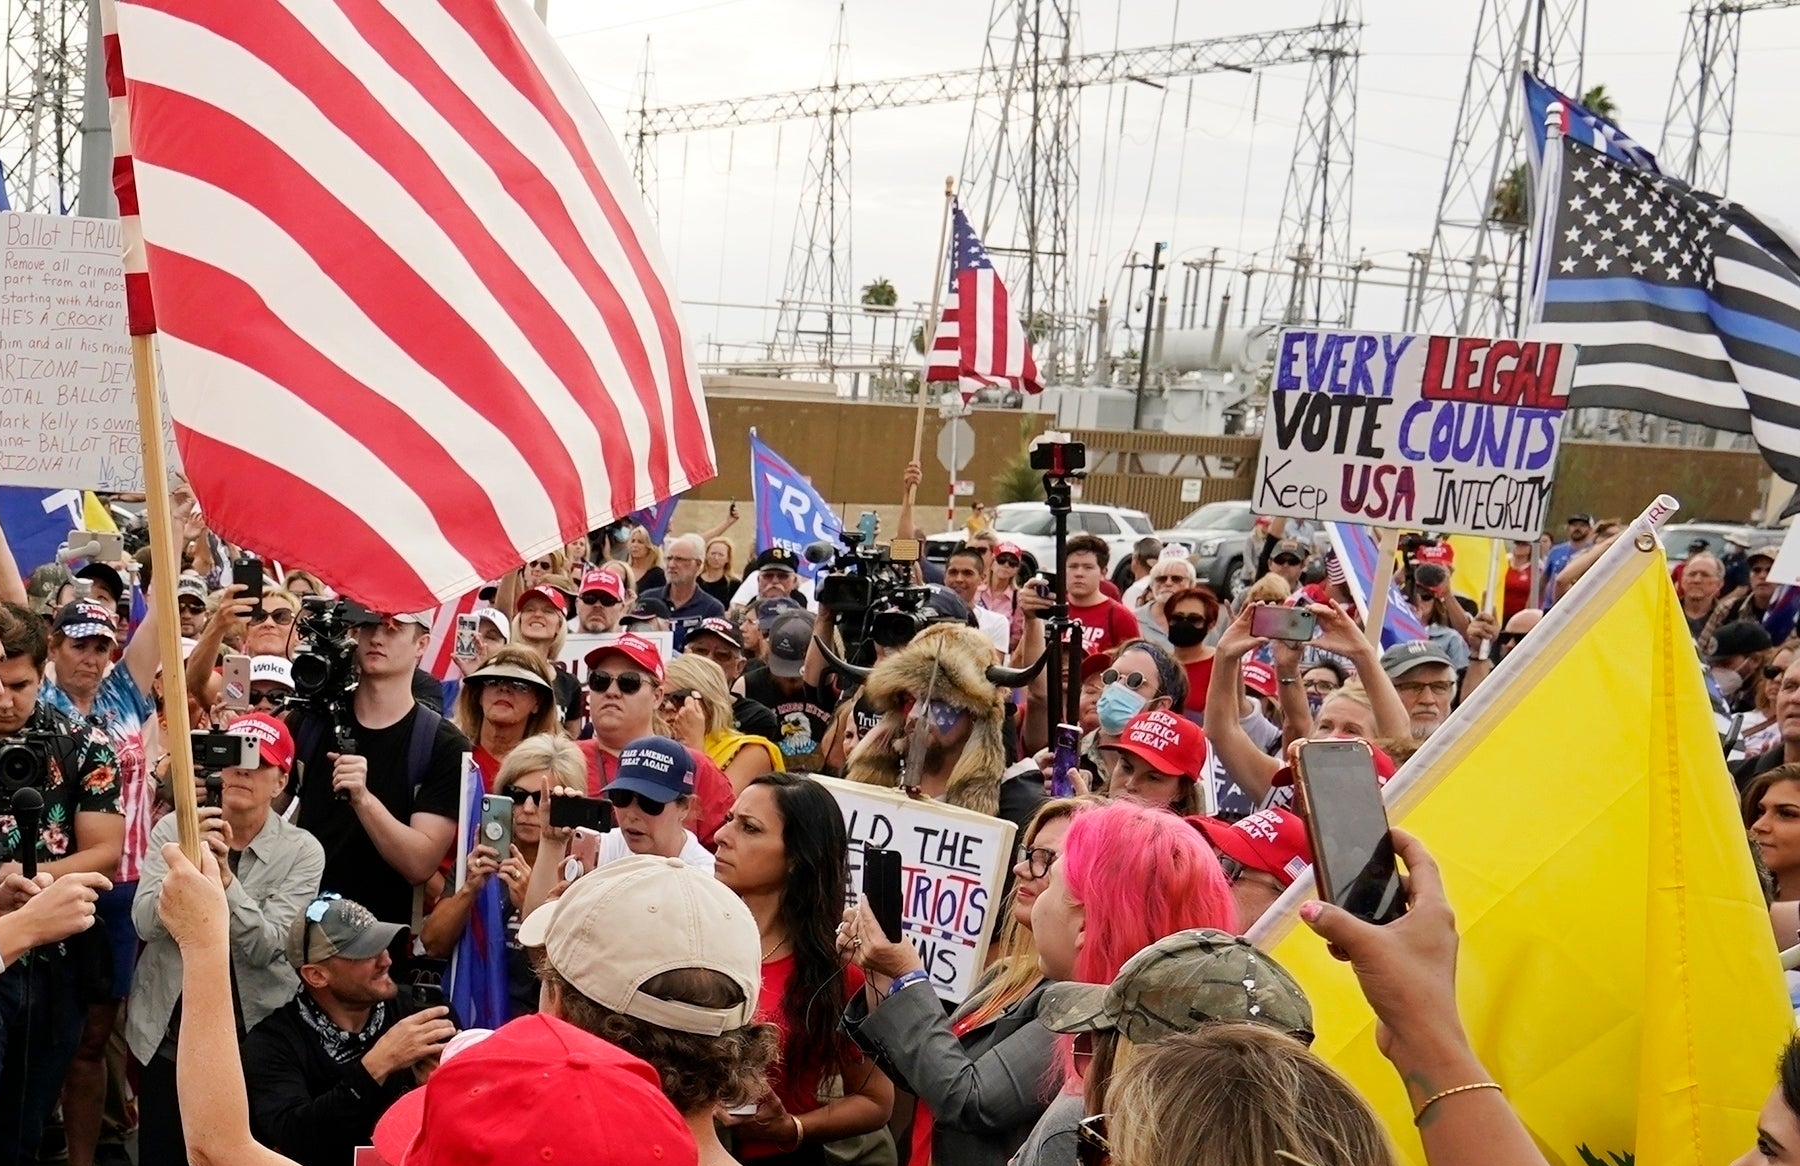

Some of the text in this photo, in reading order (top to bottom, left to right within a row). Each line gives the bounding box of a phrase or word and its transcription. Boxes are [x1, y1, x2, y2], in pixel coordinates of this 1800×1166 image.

[5, 213, 122, 249] Ballot FRAU
[4, 251, 45, 272] Remove
[53, 254, 69, 273] all
[3, 273, 33, 291] part
[42, 273, 74, 288] from
[80, 272, 96, 289] all
[1, 292, 122, 310] starting with Adrian
[1, 308, 34, 326] HE'S
[40, 312, 49, 325] A
[0, 331, 23, 350] him
[28, 337, 50, 349] and
[55, 338, 72, 350] all
[81, 338, 98, 353] his
[1278, 332, 1569, 410] EVERY LEGAL
[57, 386, 123, 406] BALLOT
[40, 410, 75, 434] Kelly
[86, 412, 99, 430] is
[103, 417, 140, 432] owne
[1272, 389, 1563, 470] VOTE COUNTS
[39, 434, 102, 454] BALLOT
[1259, 456, 1553, 532] Keep USA INTEGRITY
[253, 662, 284, 675] Woke
[1149, 711, 1178, 727] KEEP
[1129, 730, 1169, 751] GREAT
[1130, 720, 1180, 746] AMERICA
[914, 827, 983, 870] THE
